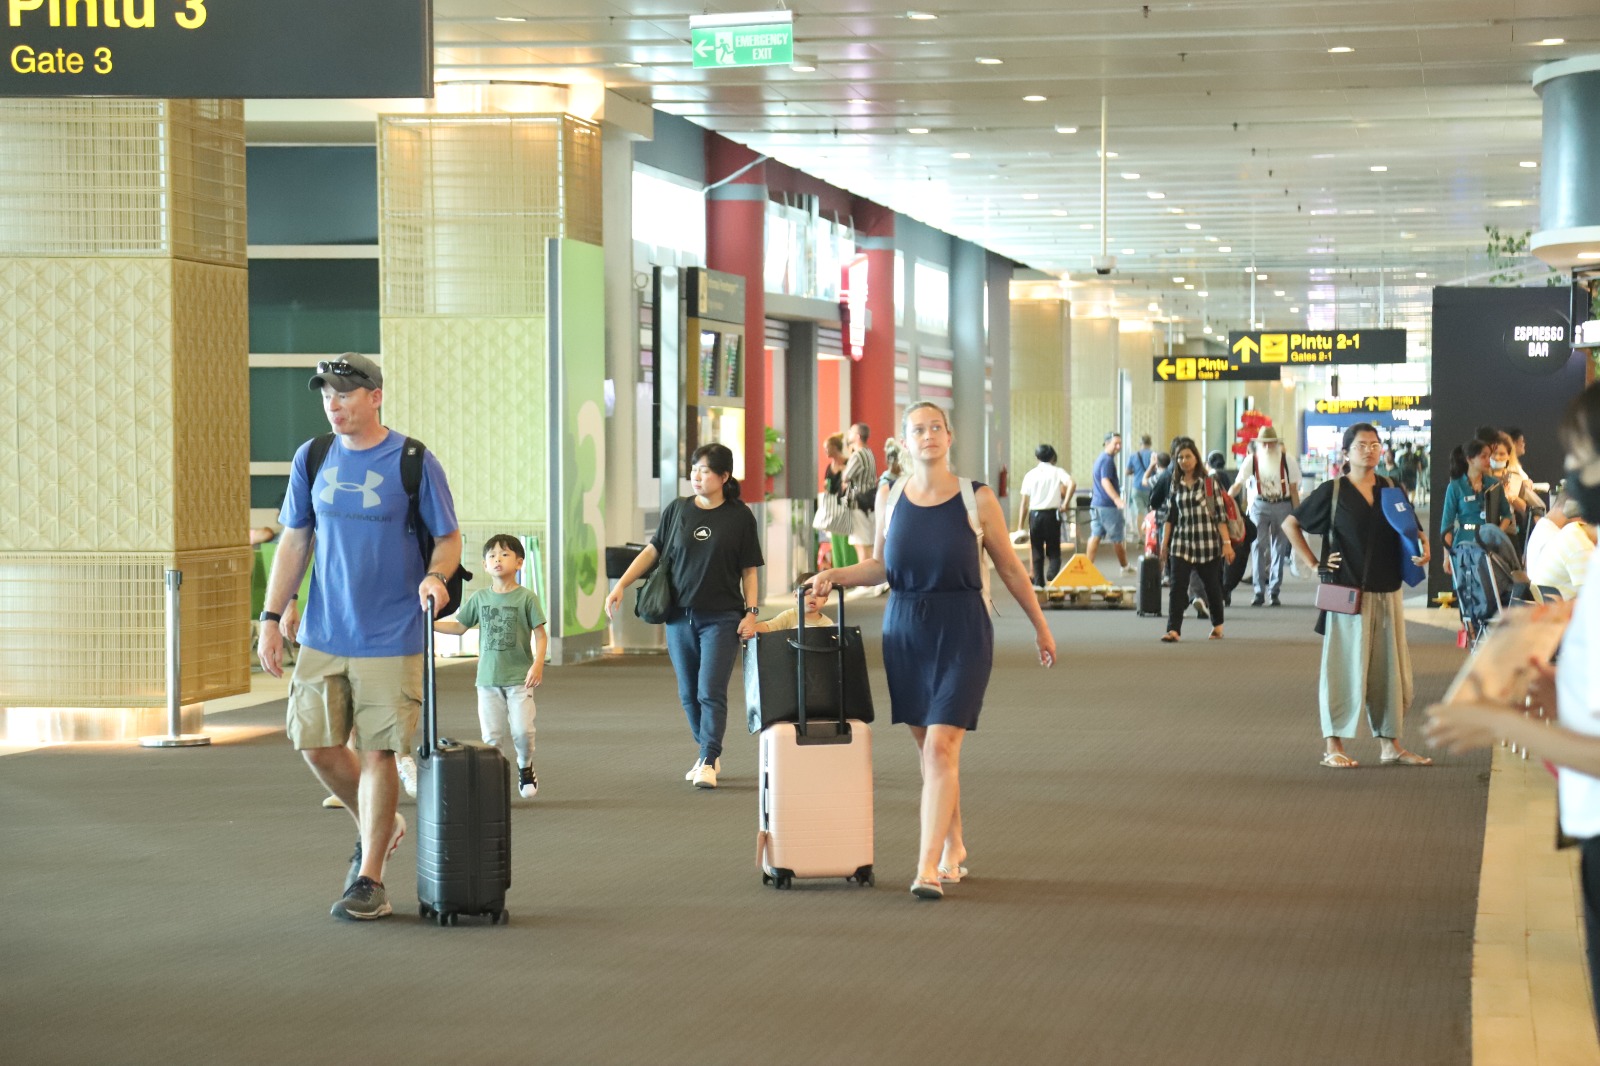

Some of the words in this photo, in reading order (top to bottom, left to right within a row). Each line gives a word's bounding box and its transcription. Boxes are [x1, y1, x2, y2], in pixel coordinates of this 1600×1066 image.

[9, 0, 155, 28] Pintu
[175, 0, 207, 29] 3
[735, 33, 788, 47] EMERGENCY
[11, 45, 84, 73] Gate
[94, 47, 113, 74] 3
[752, 48, 772, 60] EXIT
[1514, 326, 1563, 341] ESPRESSO
[1291, 334, 1332, 349] Pintu
[1337, 334, 1360, 349] 2-1
[1291, 352, 1316, 362] Gates
[1528, 342, 1549, 357] BAR
[1198, 358, 1228, 371] Pintu
[345, 512, 392, 522] ARMOUR
[577, 400, 606, 629] 3
